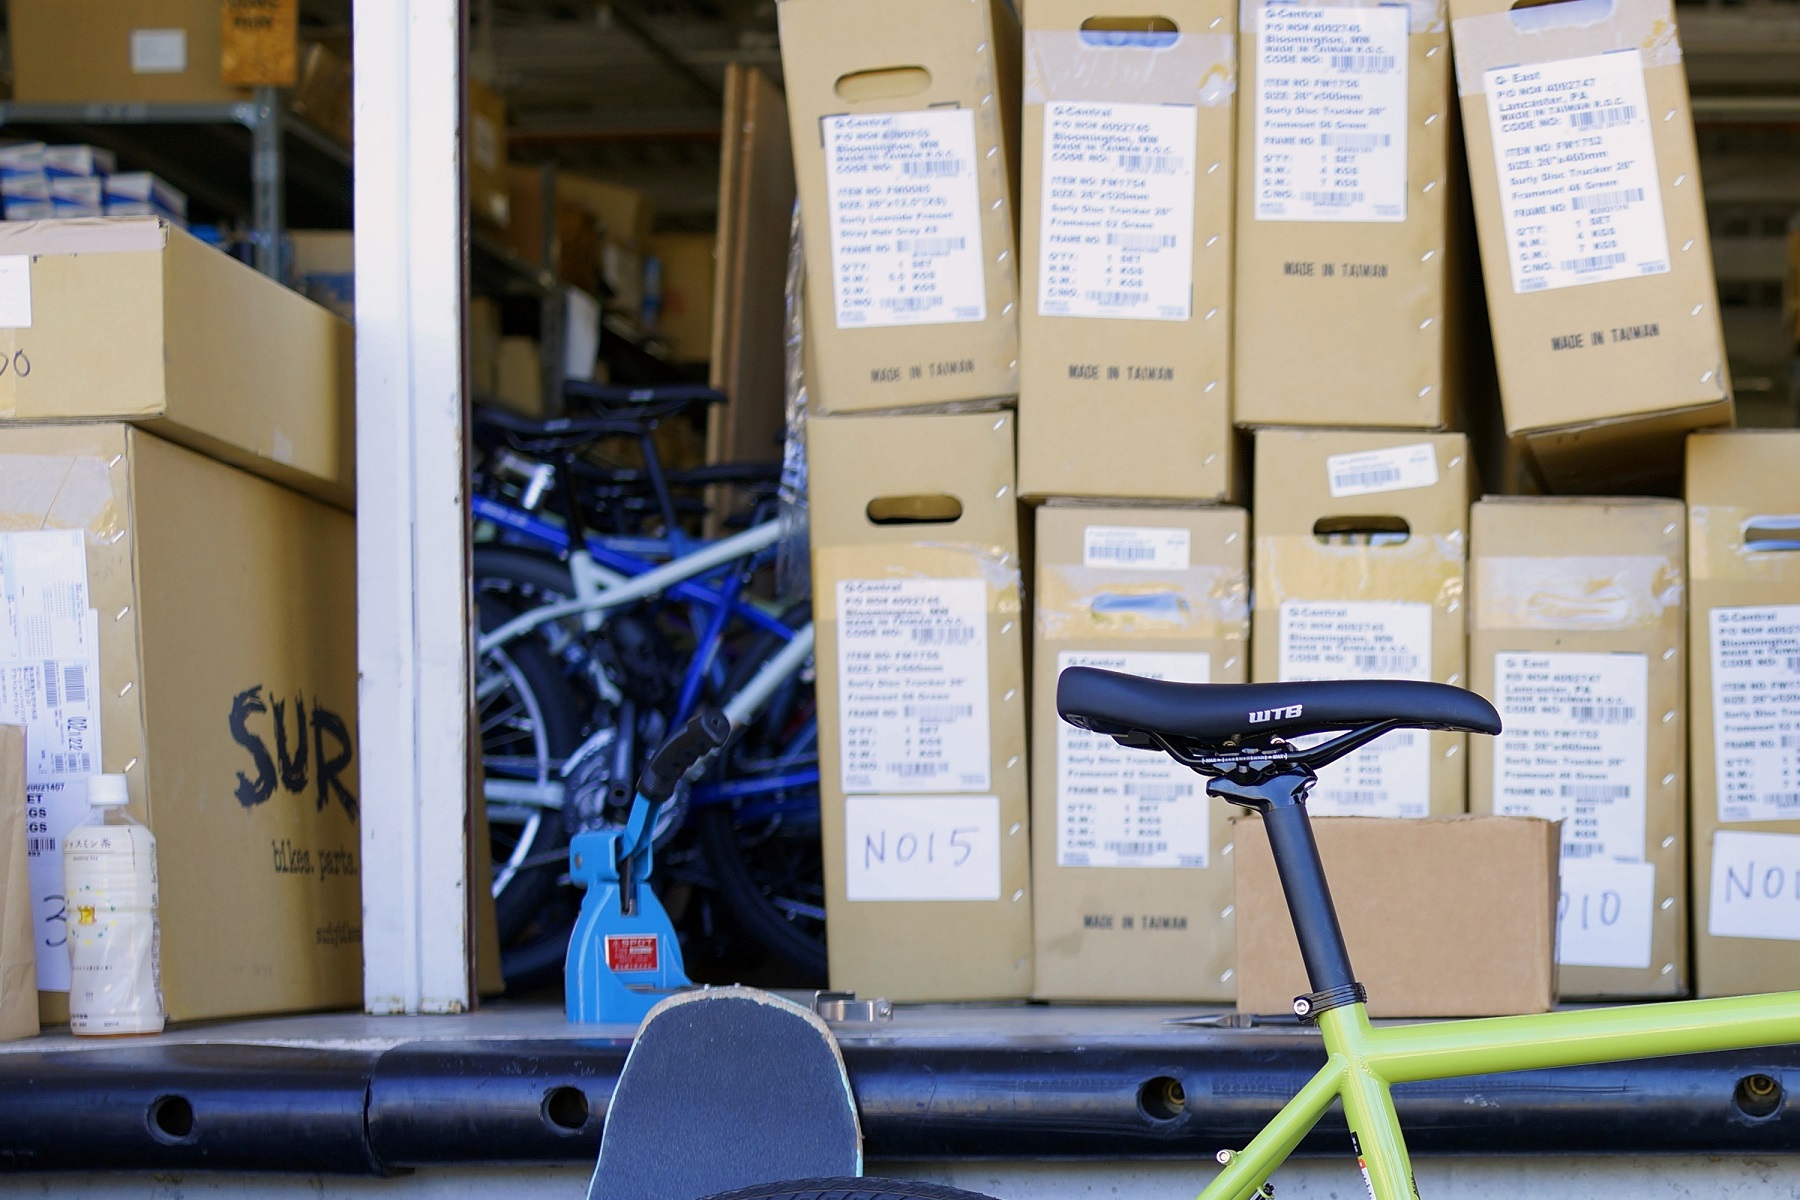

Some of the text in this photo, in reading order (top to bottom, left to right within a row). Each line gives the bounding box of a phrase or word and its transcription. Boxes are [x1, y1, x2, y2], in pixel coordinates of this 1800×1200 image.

[1284, 262, 1388, 278] MADE IN TAIWAN
[1552, 322, 1660, 350] MADE IN TAIWAN
[870, 358, 975, 384] MADE IN TAIWAN
[1068, 364, 1174, 381] MADE IN TAIWAN
[1248, 704, 1303, 724] WTB
[229, 684, 361, 825] SUR
[1084, 914, 1188, 930] MADE IN TAIWAN
